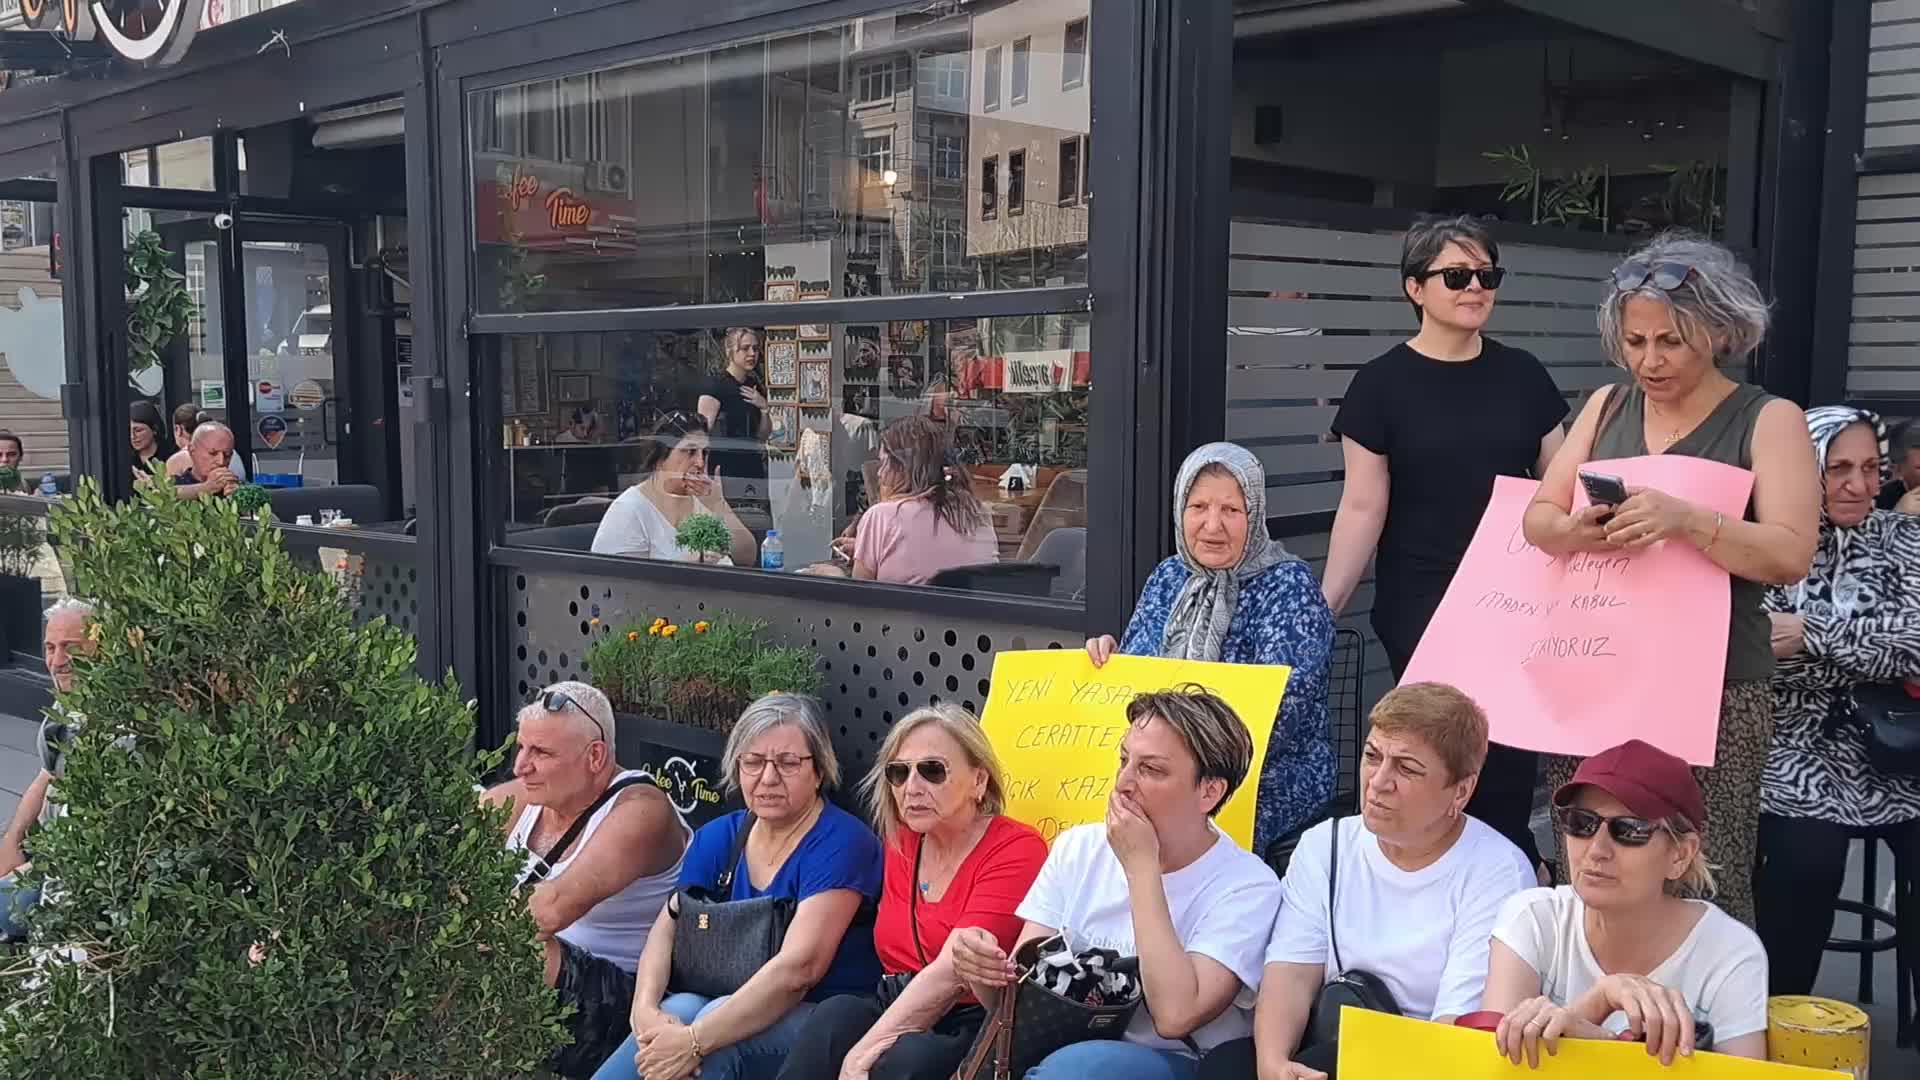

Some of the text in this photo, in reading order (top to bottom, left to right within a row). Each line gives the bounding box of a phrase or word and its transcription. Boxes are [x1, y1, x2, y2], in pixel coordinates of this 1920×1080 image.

[545, 187, 589, 229] Time
[1570, 593, 1627, 610] KABUL
[691, 778, 720, 803] Time
